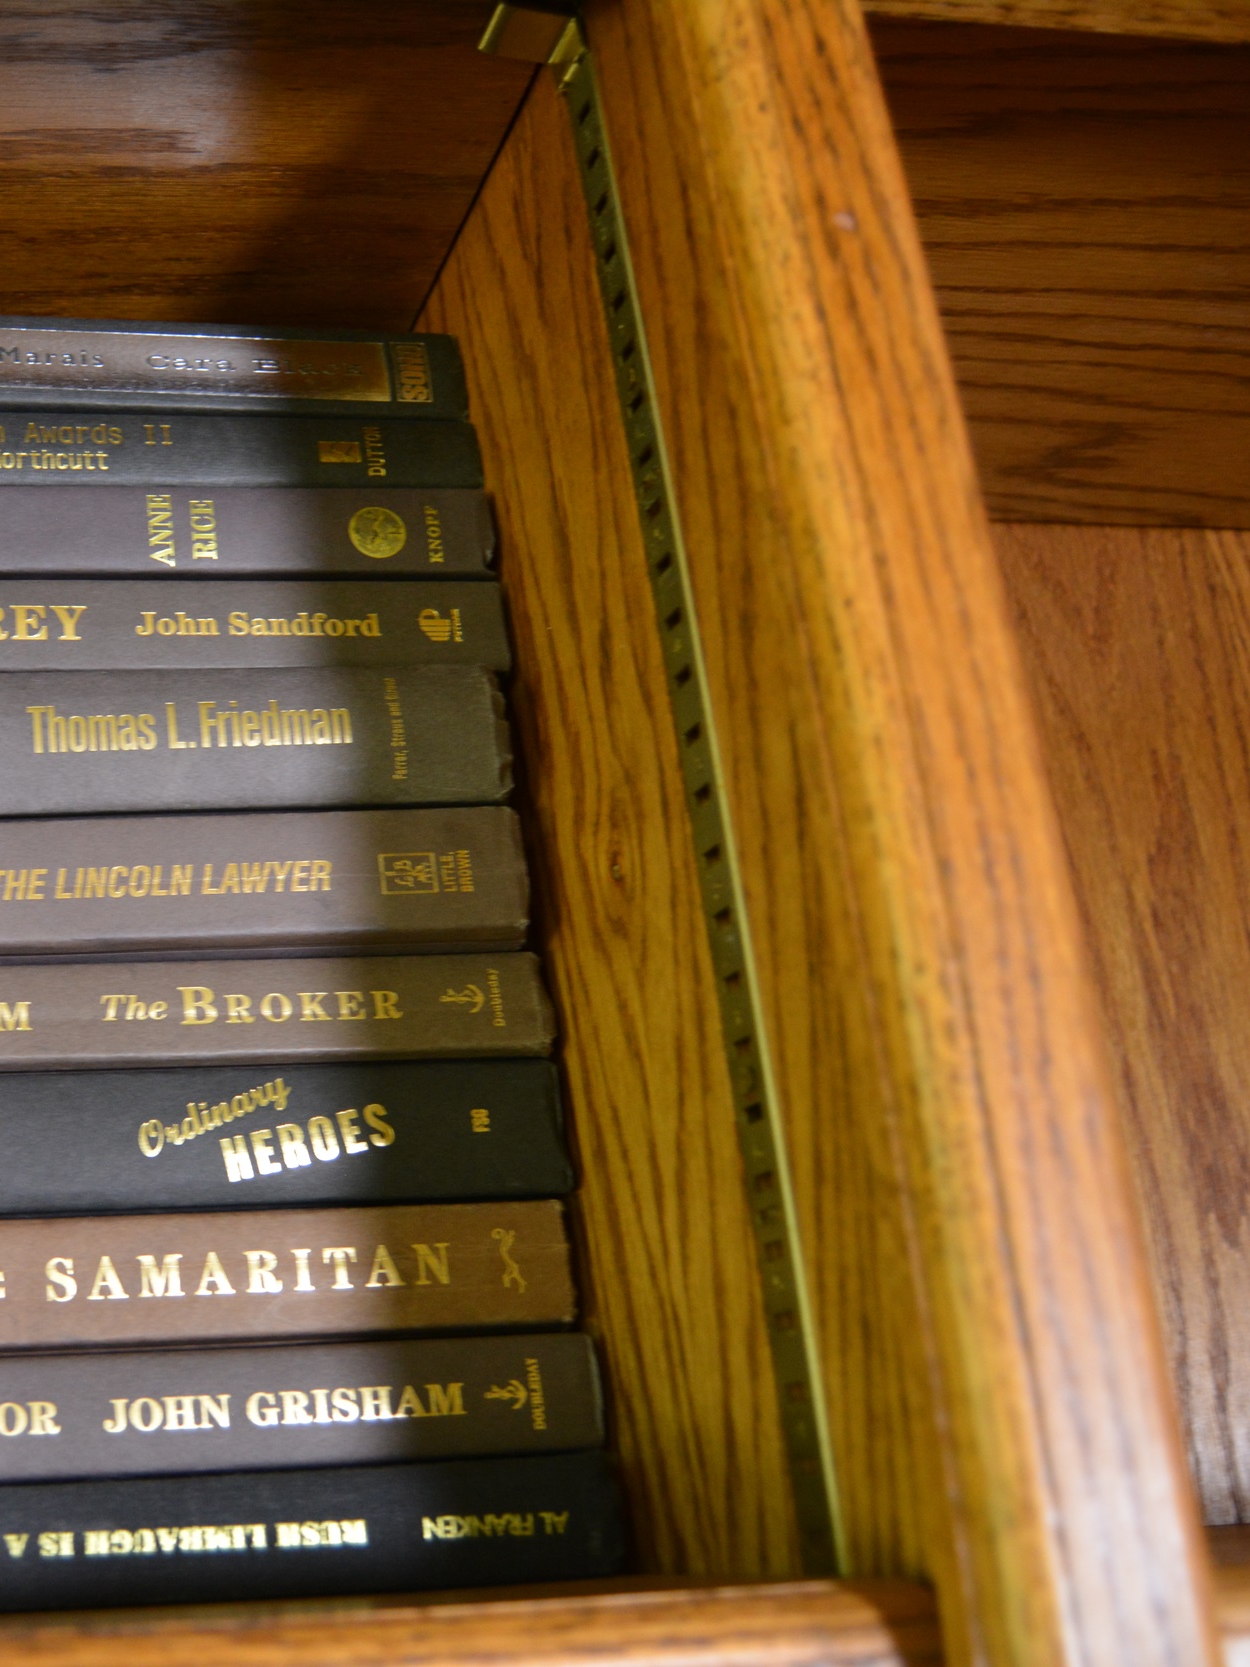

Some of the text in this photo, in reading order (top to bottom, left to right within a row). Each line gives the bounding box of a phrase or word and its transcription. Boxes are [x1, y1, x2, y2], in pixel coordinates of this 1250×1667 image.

[146, 355, 237, 372] Cara
[252, 358, 364, 376] Black
[24, 422, 124, 446] Awards
[143, 424, 173, 446] II
[363, 426, 387, 477] DUTTON
[146, 494, 176, 567] ANNE
[189, 500, 219, 560] RICE
[423, 505, 445, 564] KNOPF
[135, 611, 383, 638] John Sandford
[26, 699, 353, 754] Thomas L. Friedman
[386, 702, 402, 717] and
[54, 864, 194, 899] LINCOLN
[201, 859, 333, 895] LAWYER
[439, 851, 458, 892] LITTLE,
[455, 849, 475, 892] BROWN
[99, 986, 405, 1026] The BROKER
[487, 967, 506, 1027] Doubleday
[137, 1077, 292, 1158] Ordinary
[219, 1103, 396, 1183] HEROES
[45, 1242, 451, 1303] SAMARITAN
[102, 1394, 232, 1434] JOHN
[245, 1382, 468, 1428] GRISHAM
[524, 1357, 547, 1431] DOUBLEDAY
[84, 1522, 266, 1557] LIMBAUGH
[274, 1519, 368, 1549] RUSH
[422, 1512, 535, 1542] FRANKEN
[537, 1511, 570, 1535] AL
[3, 1533, 29, 1557] A
[39, 1531, 74, 1560] IS
